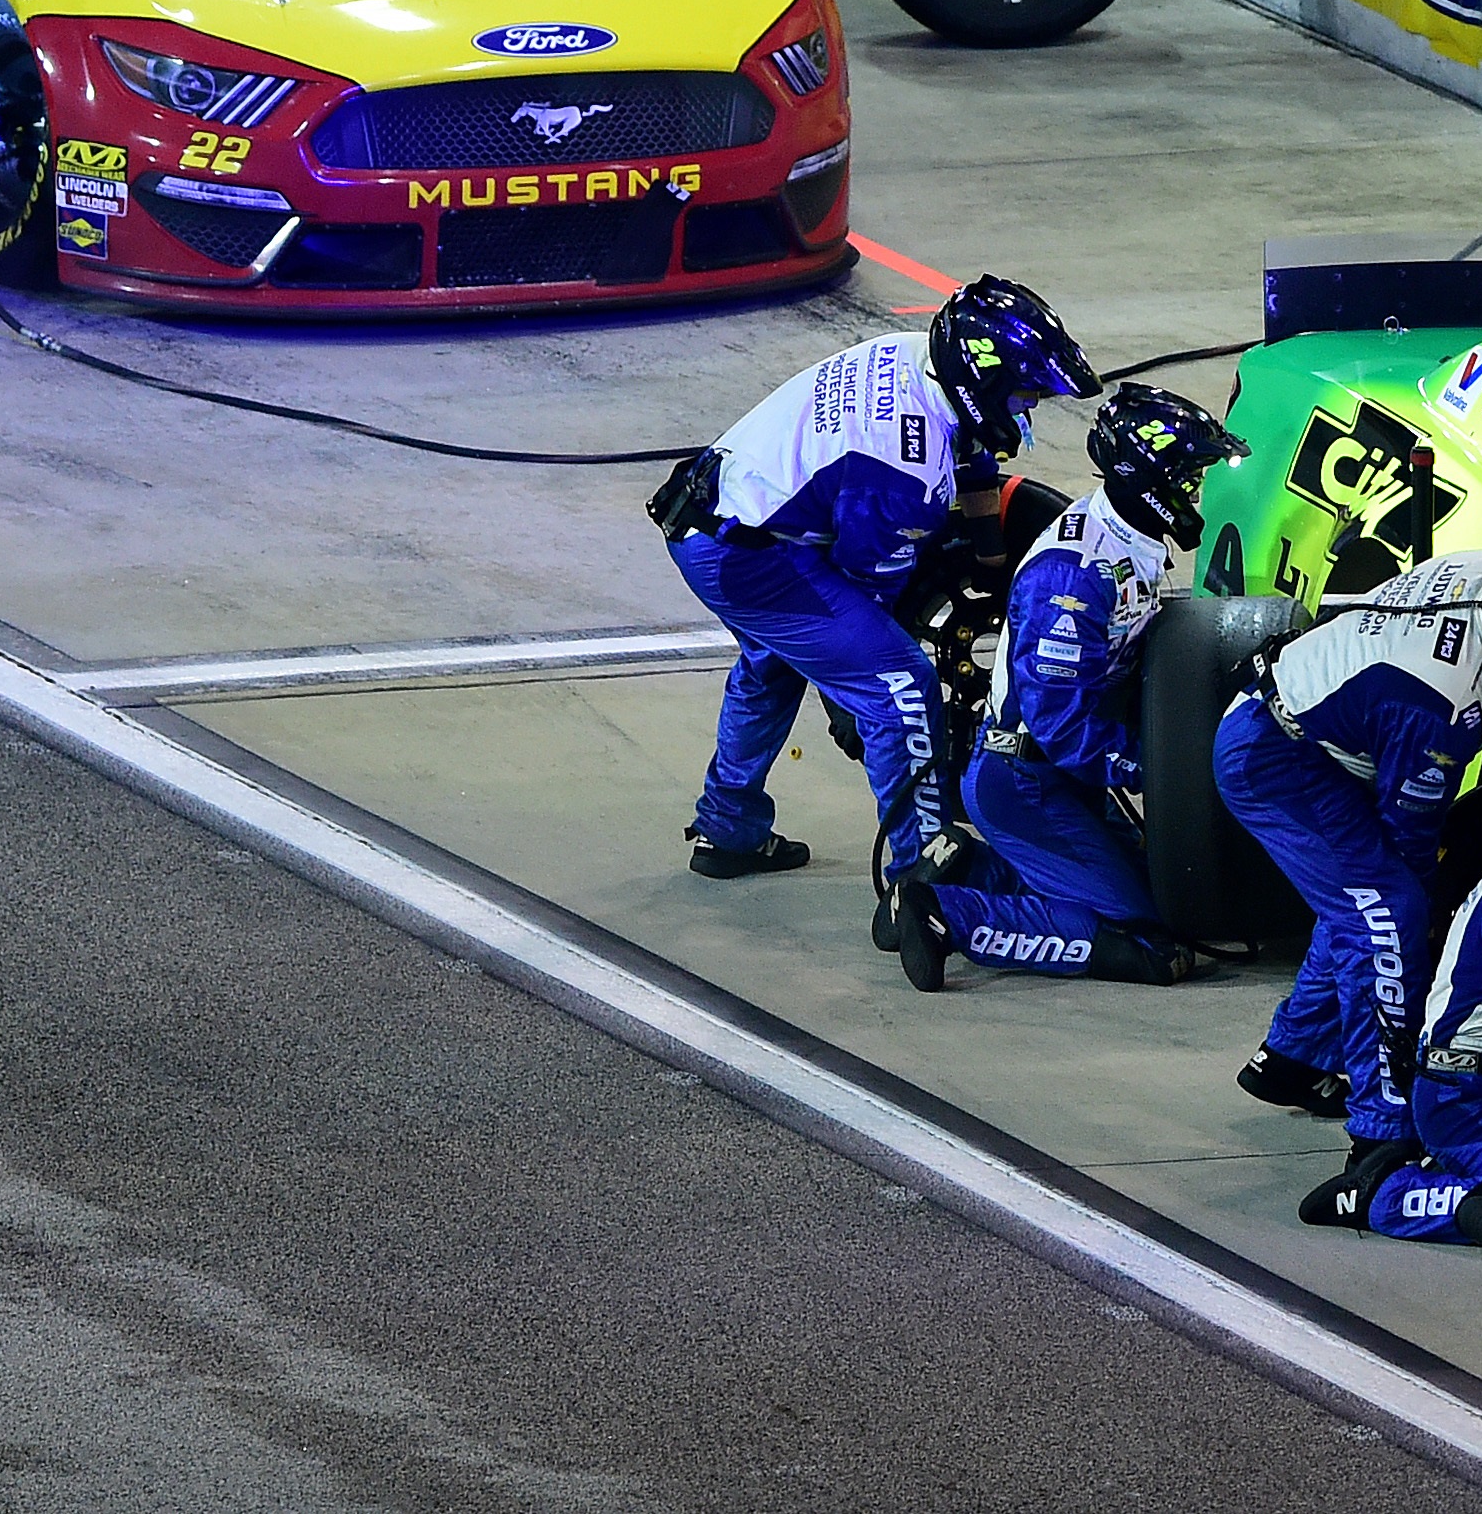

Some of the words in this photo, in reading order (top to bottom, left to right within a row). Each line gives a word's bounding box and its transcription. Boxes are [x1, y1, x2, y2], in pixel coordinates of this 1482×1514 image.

[503, 25, 587, 52] Ford
[180, 131, 251, 175] 22
[57, 175, 116, 198] LINCOLN
[70, 192, 120, 213] WELDERS
[407, 164, 703, 210] MUSTANG
[59, 222, 105, 242] SUNOCO
[968, 337, 1002, 368] 24
[814, 361, 831, 434] PROGRAMS
[830, 353, 846, 435] PROTECTION
[844, 358, 859, 414] VEHICLE
[875, 344, 898, 423] PATTON
[1444, 389, 1469, 412] Valvoline
[956, 385, 984, 424] AXALTA
[906, 417, 920, 437] 24
[1136, 418, 1177, 453] 24
[1141, 491, 1176, 526] AXALTA
[1416, 563, 1464, 629] LUDWIG
[1049, 628, 1079, 638] AXALTA
[1445, 621, 1460, 640] 24
[1042, 645, 1076, 656] SIEMENS
[969, 925, 1094, 964] GUARD
